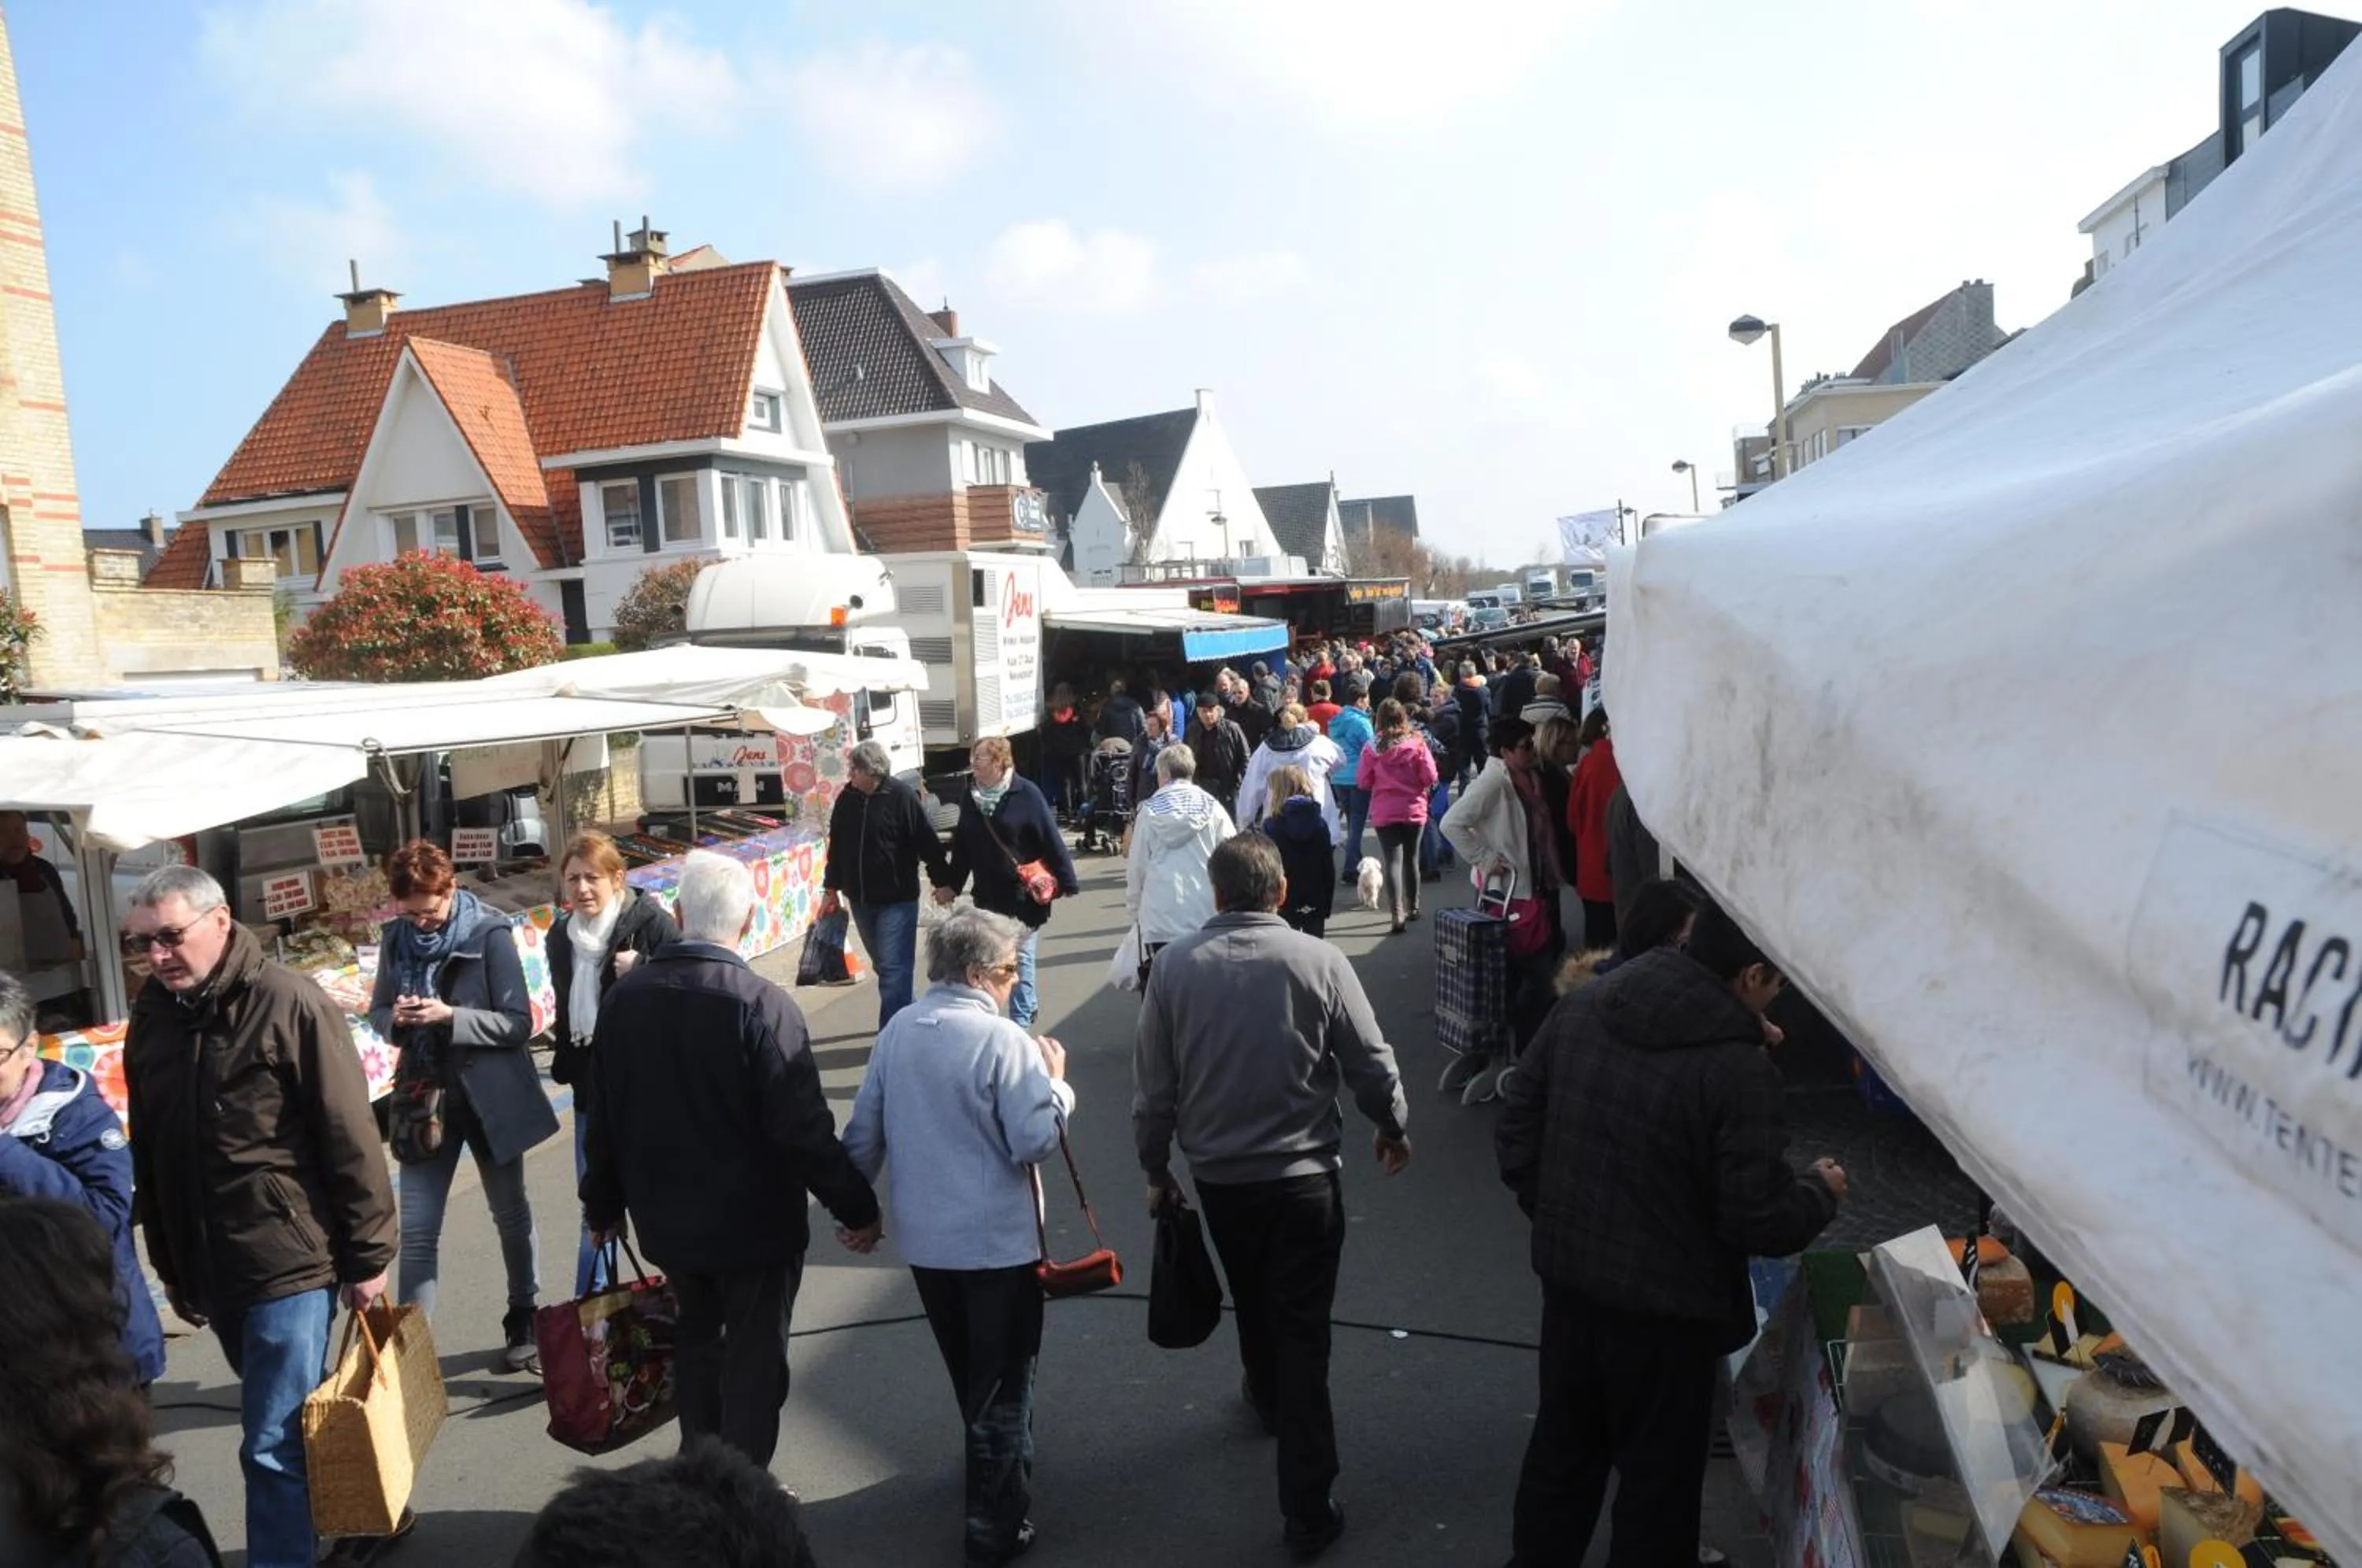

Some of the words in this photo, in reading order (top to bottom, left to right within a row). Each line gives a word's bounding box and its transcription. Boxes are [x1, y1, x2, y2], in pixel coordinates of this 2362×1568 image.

[1001, 571, 1033, 628] Jens
[733, 745, 766, 765] Jens
[2186, 1048, 2362, 1199] WWW.TENTE
